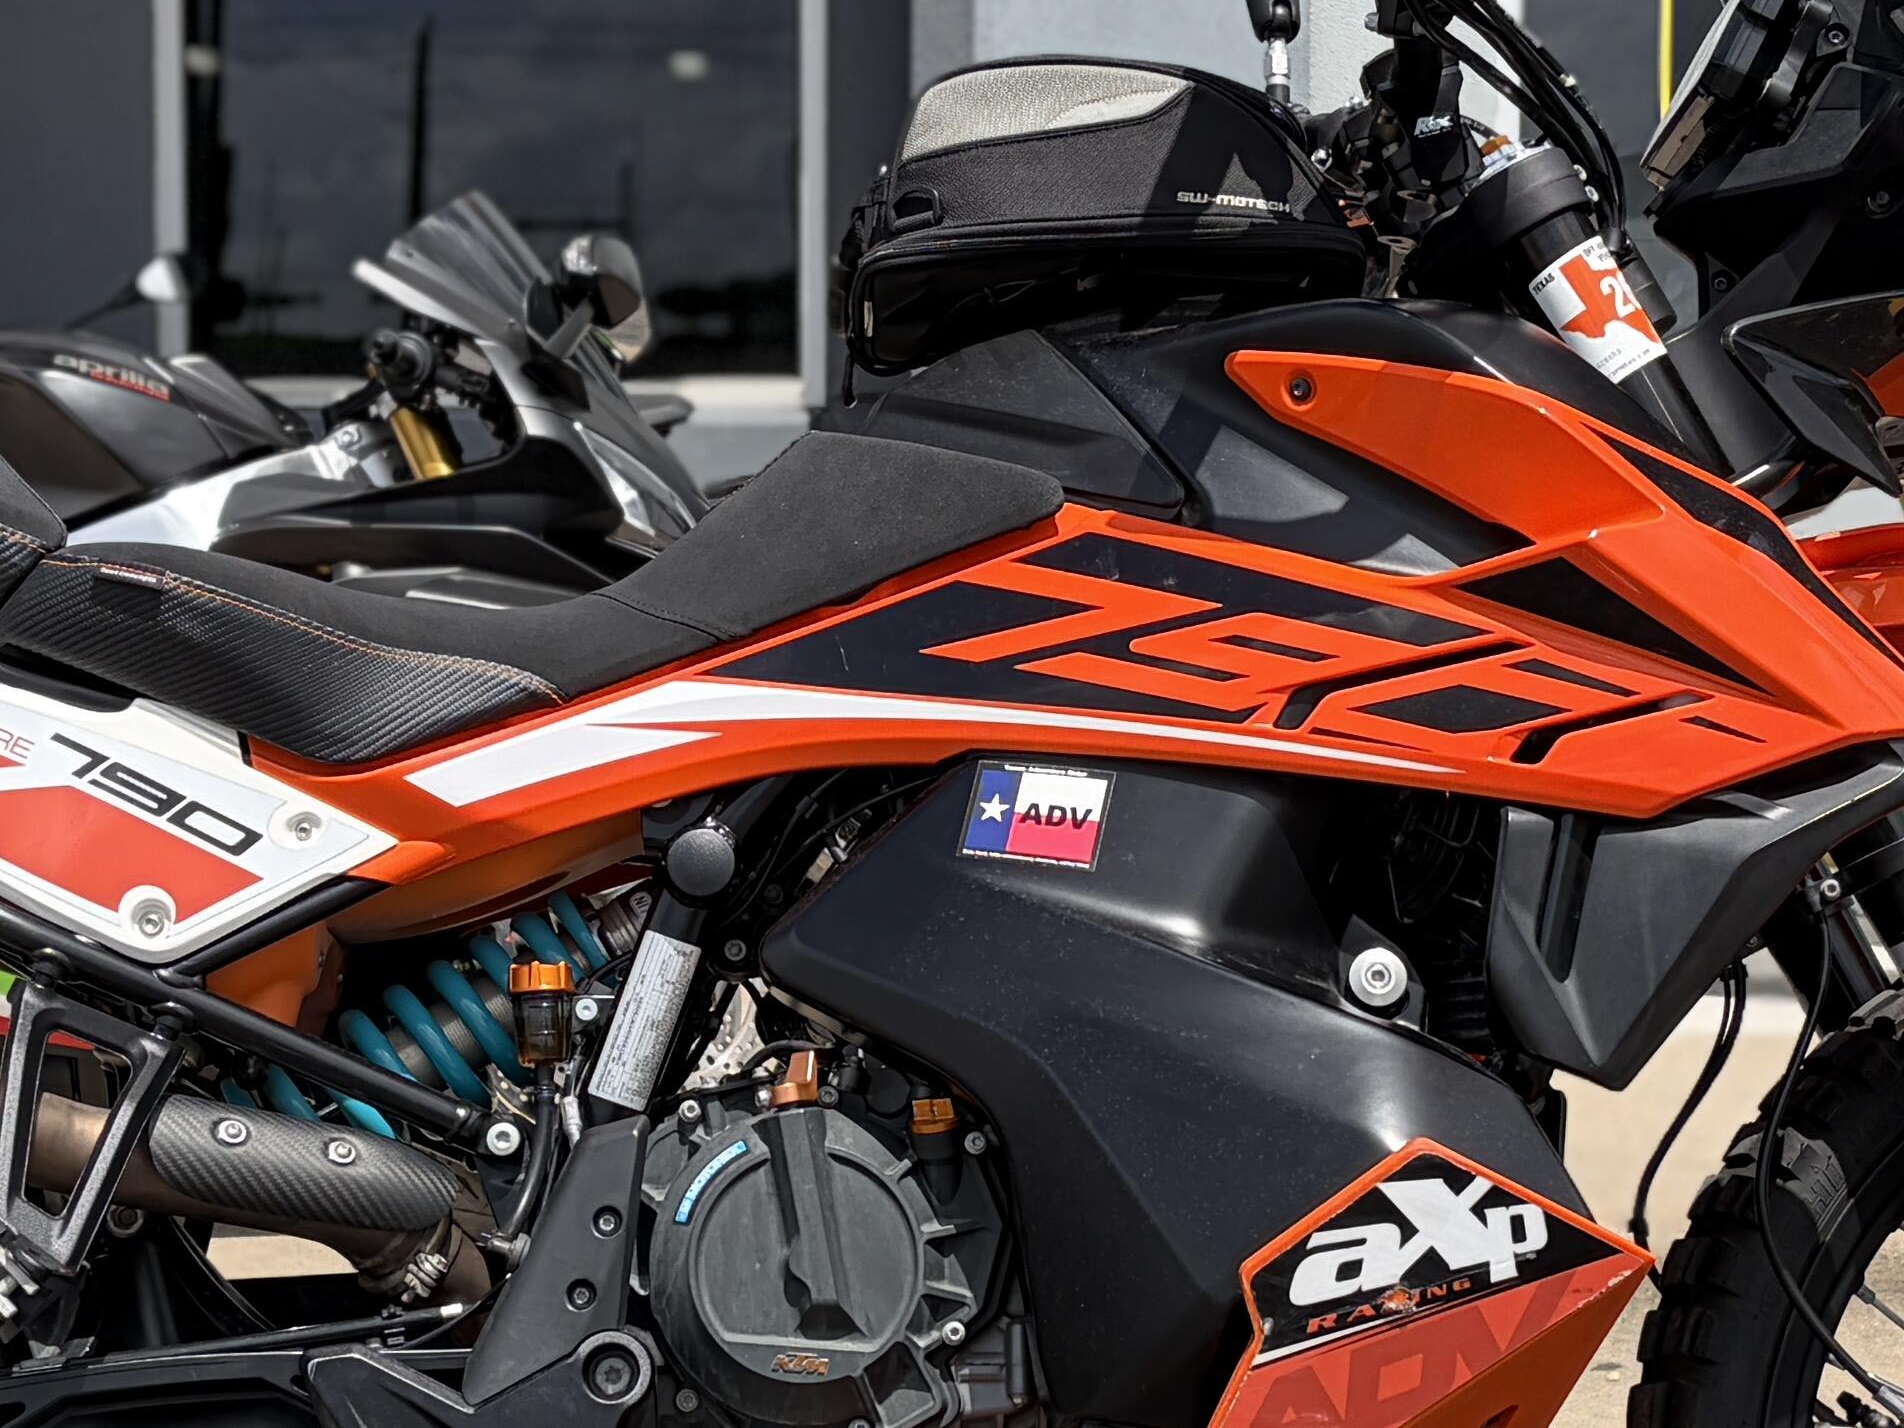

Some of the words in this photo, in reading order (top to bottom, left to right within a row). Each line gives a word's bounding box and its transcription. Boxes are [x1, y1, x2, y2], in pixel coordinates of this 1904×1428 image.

[1176, 191, 1290, 213] SW-MOTECH
[1532, 272, 1556, 295] TEXAS
[49, 732, 264, 857] 790
[1018, 802, 1093, 830] ADV
[769, 1351, 831, 1376] KTM
